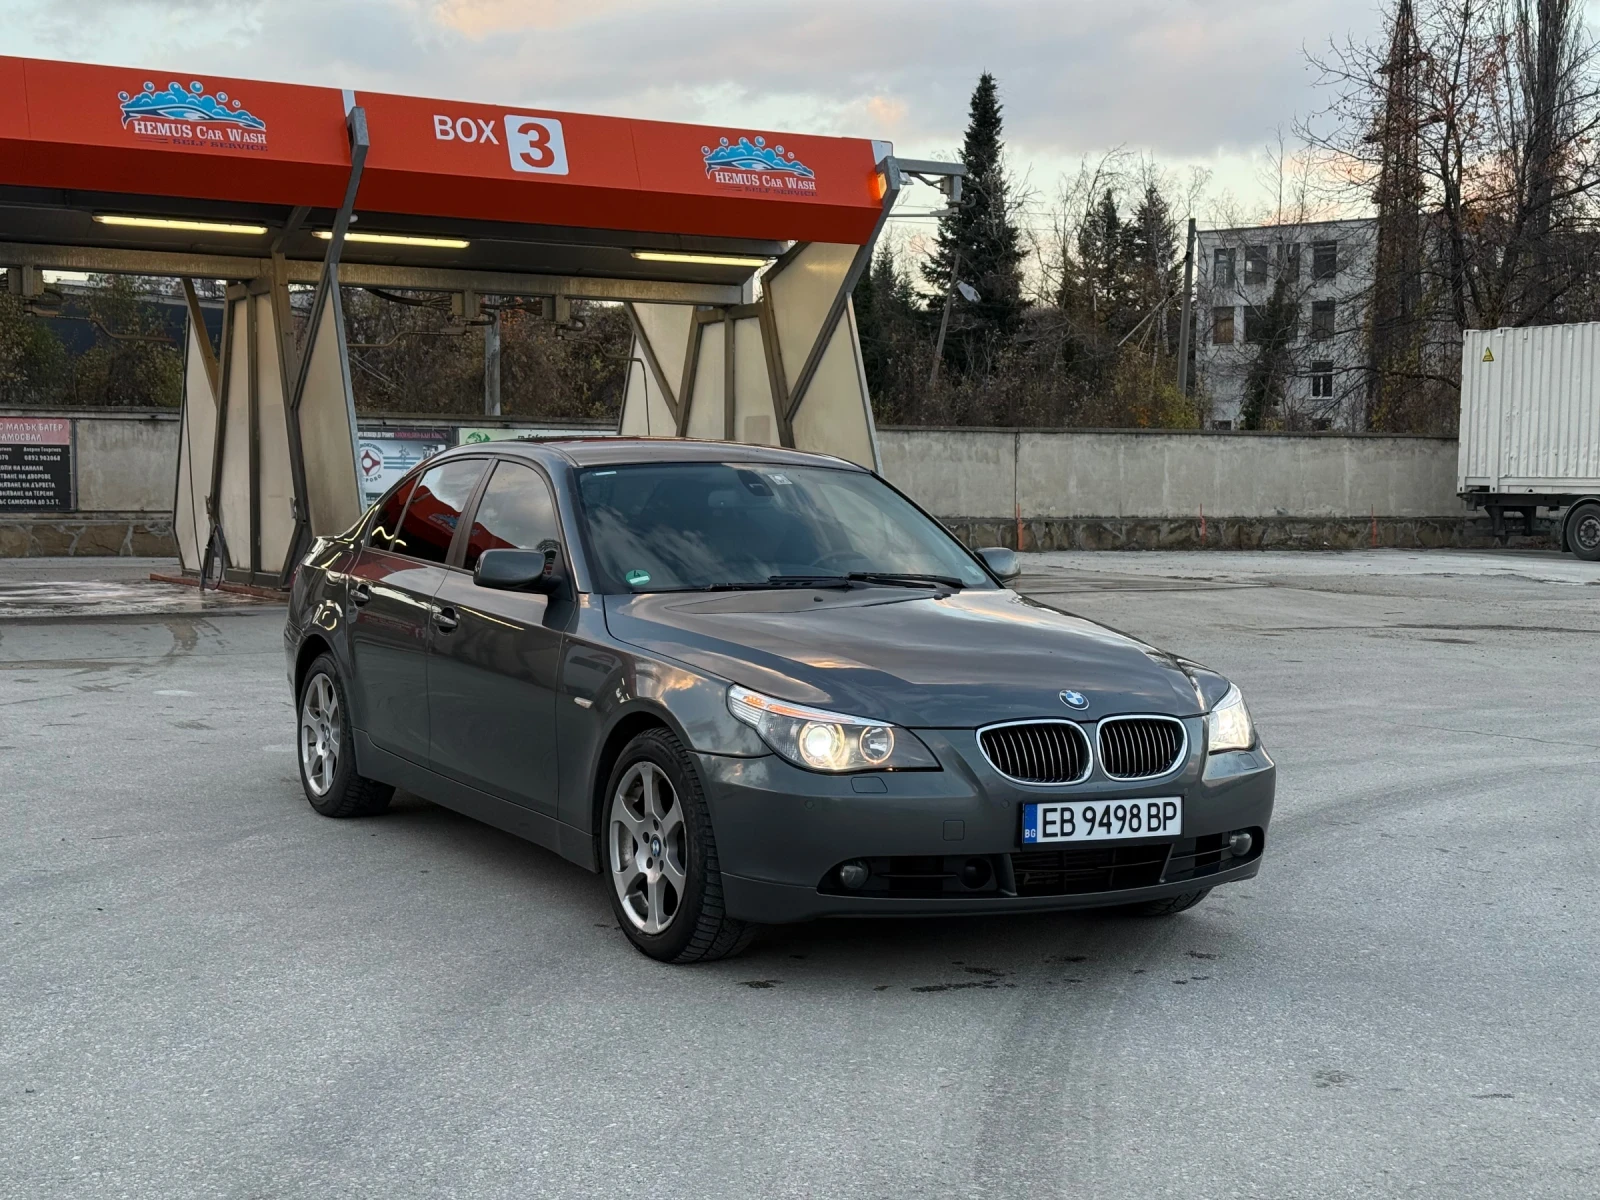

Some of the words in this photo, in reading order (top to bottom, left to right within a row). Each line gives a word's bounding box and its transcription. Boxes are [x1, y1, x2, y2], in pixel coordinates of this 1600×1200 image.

[133, 120, 193, 138] HEMUS
[433, 114, 500, 145] BOX
[172, 138, 207, 147] SELF
[210, 141, 269, 152] SERVICE
[517, 122, 555, 168] 3
[714, 171, 760, 186] HEMUS
[744, 186, 771, 194] SELF
[773, 189, 818, 197] SERVICE
[0, 433, 42, 442] АМОСВАЛ
[1042, 806, 1076, 838] EB
[1082, 803, 1142, 836] 9498
[1147, 802, 1177, 833] BP
[1024, 828, 1036, 838] BG
